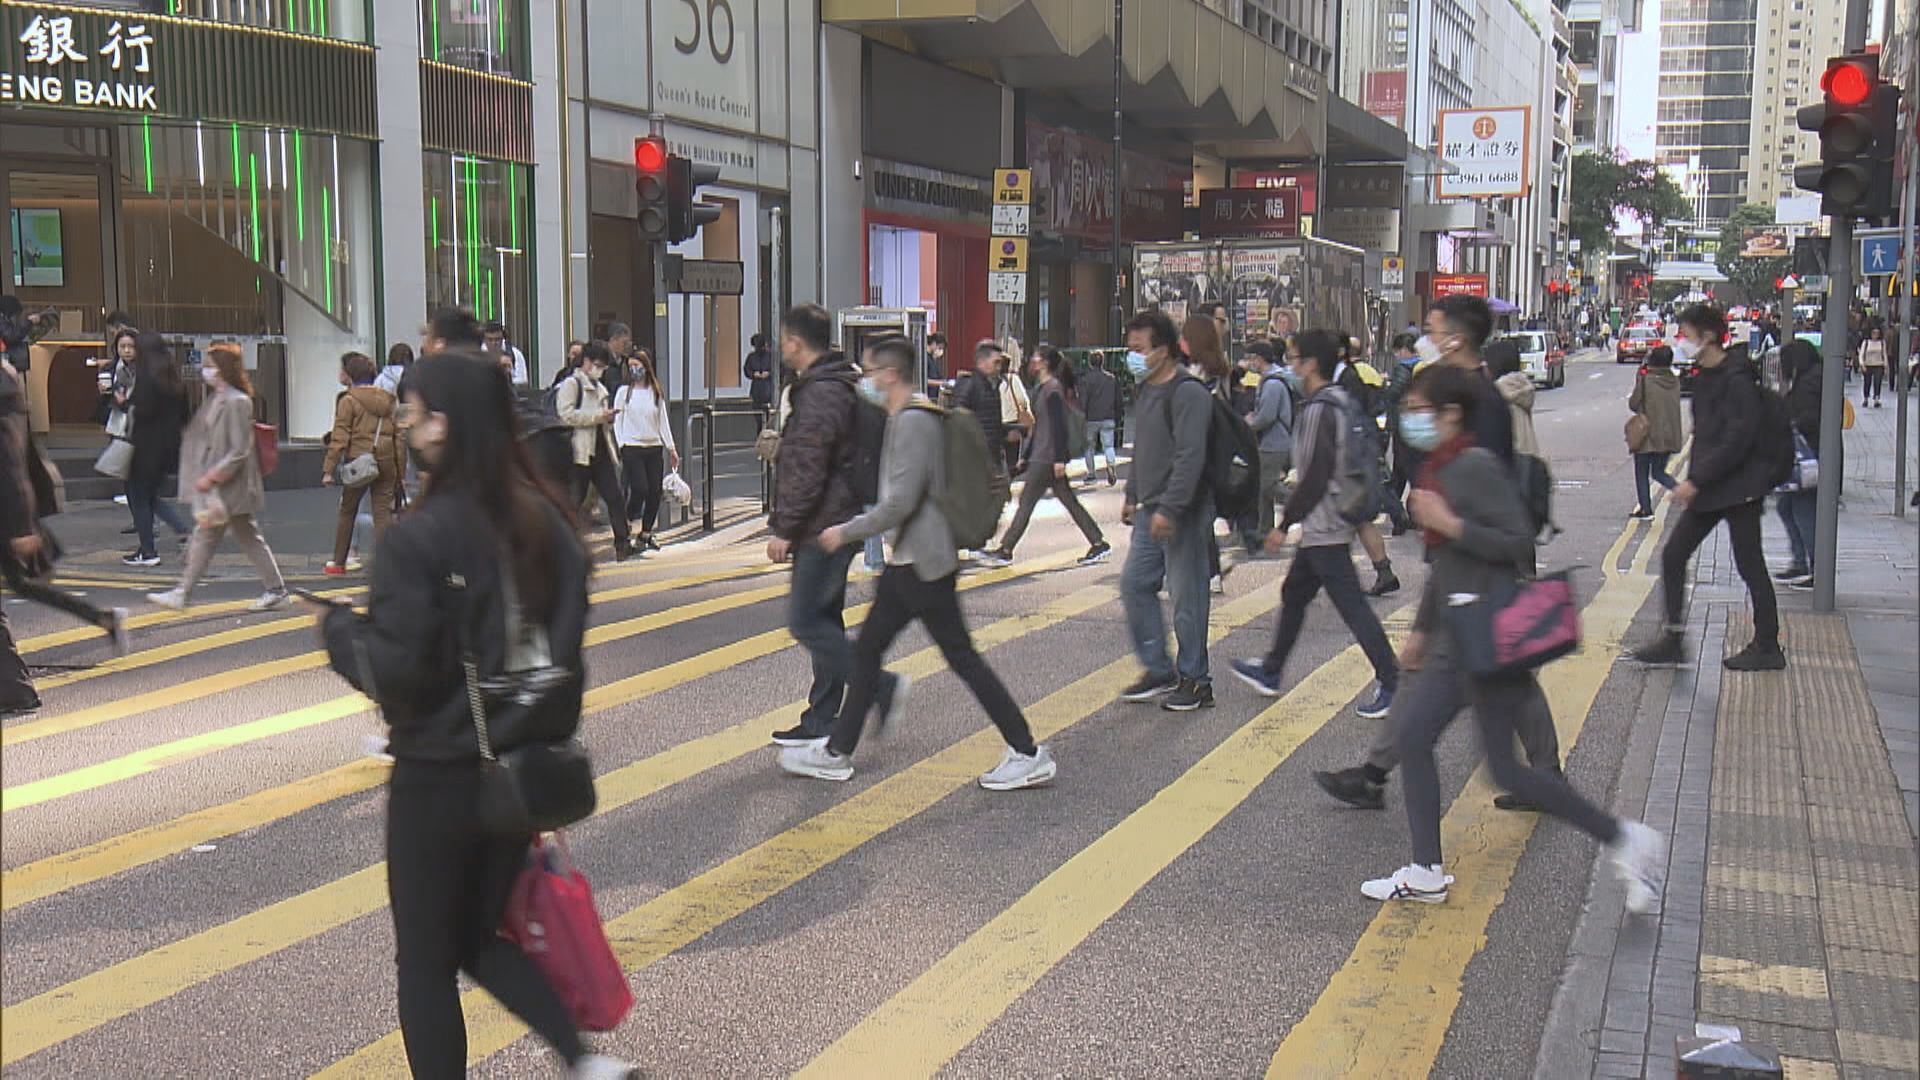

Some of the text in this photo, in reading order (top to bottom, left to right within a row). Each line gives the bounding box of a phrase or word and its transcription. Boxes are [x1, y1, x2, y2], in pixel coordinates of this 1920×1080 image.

[19, 14, 153, 73] 銀行
[74, 78, 157, 110] BANK
[657, 80, 752, 118] Queen's Road Central
[1459, 171, 1519, 184] 3961 6688
[1016, 207, 1022, 218] 7
[1214, 197, 1285, 220] 周大福
[1015, 223, 1028, 235] 12
[1012, 275, 1020, 286] 7
[1012, 291, 1019, 302] 7
